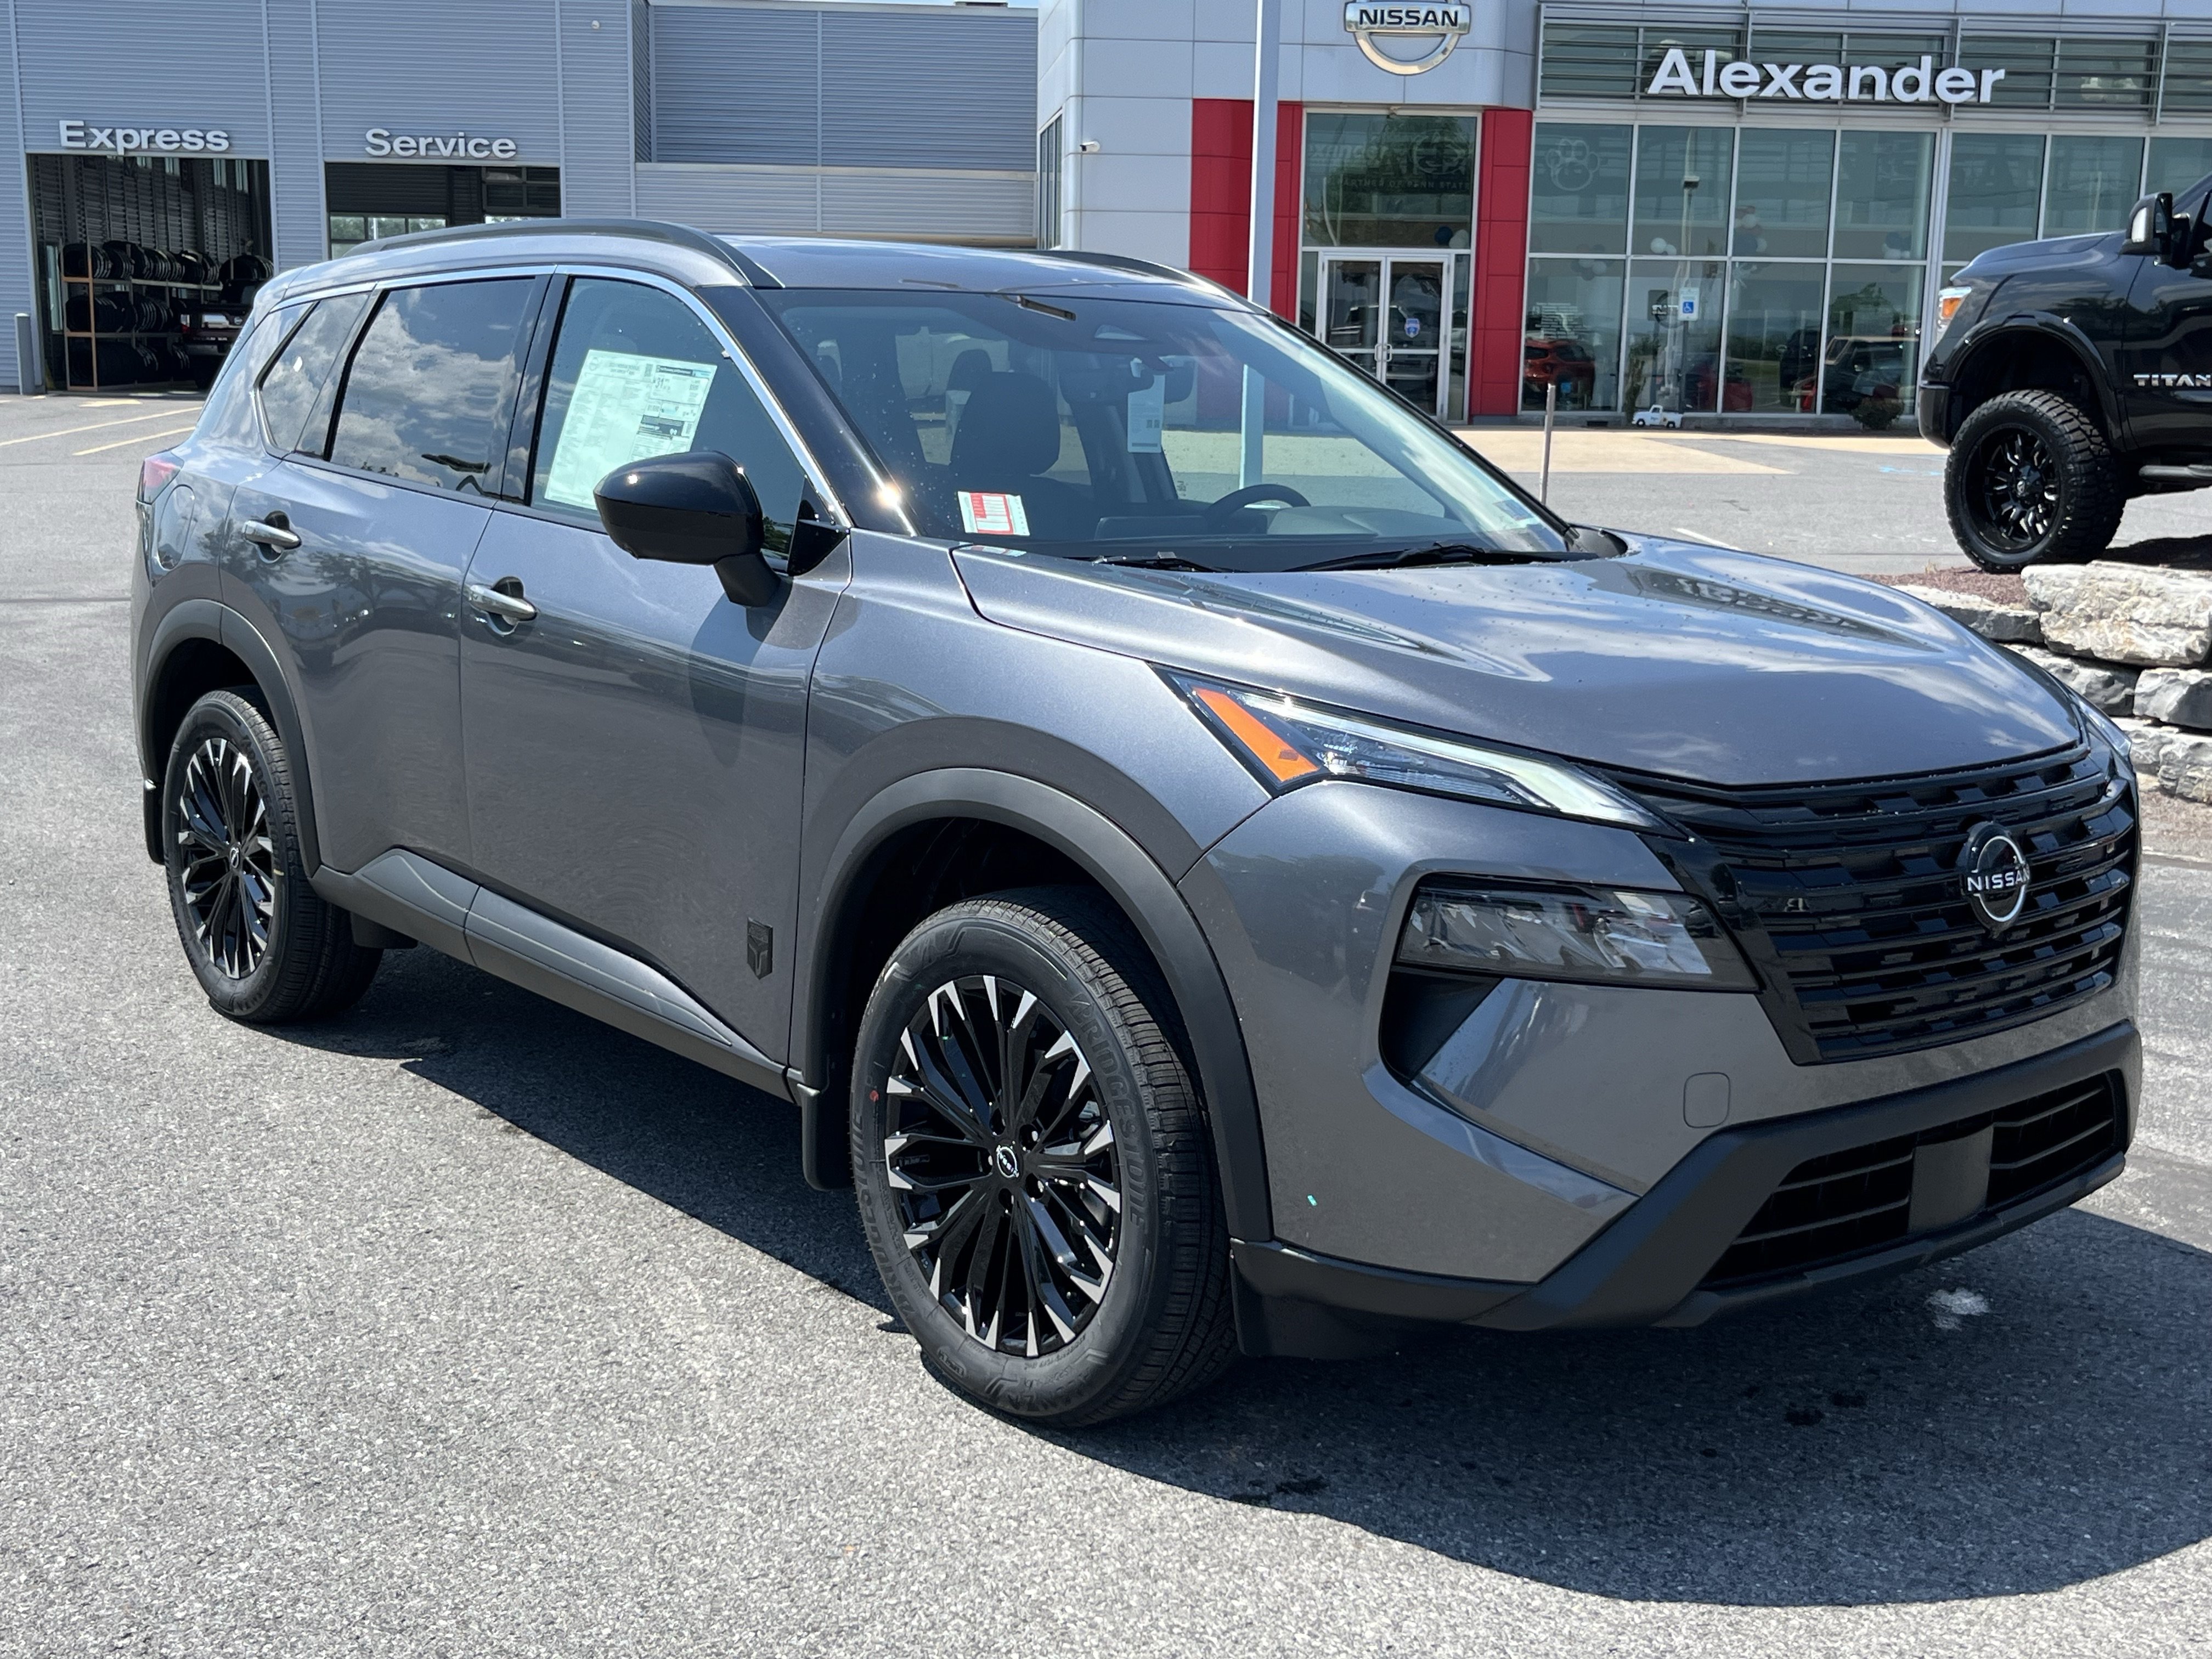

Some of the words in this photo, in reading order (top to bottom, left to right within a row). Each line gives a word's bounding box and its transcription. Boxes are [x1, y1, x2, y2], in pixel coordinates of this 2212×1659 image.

[1359, 9, 1458, 27] NISSAN
[1647, 47, 2006, 104] Alexander
[58, 120, 231, 155] Express
[365, 128, 518, 160] Service
[2133, 374, 2211, 387] TITAN
[1967, 866, 2030, 891] NISSAN
[1065, 992, 1148, 1233] BRIDGESTONE
